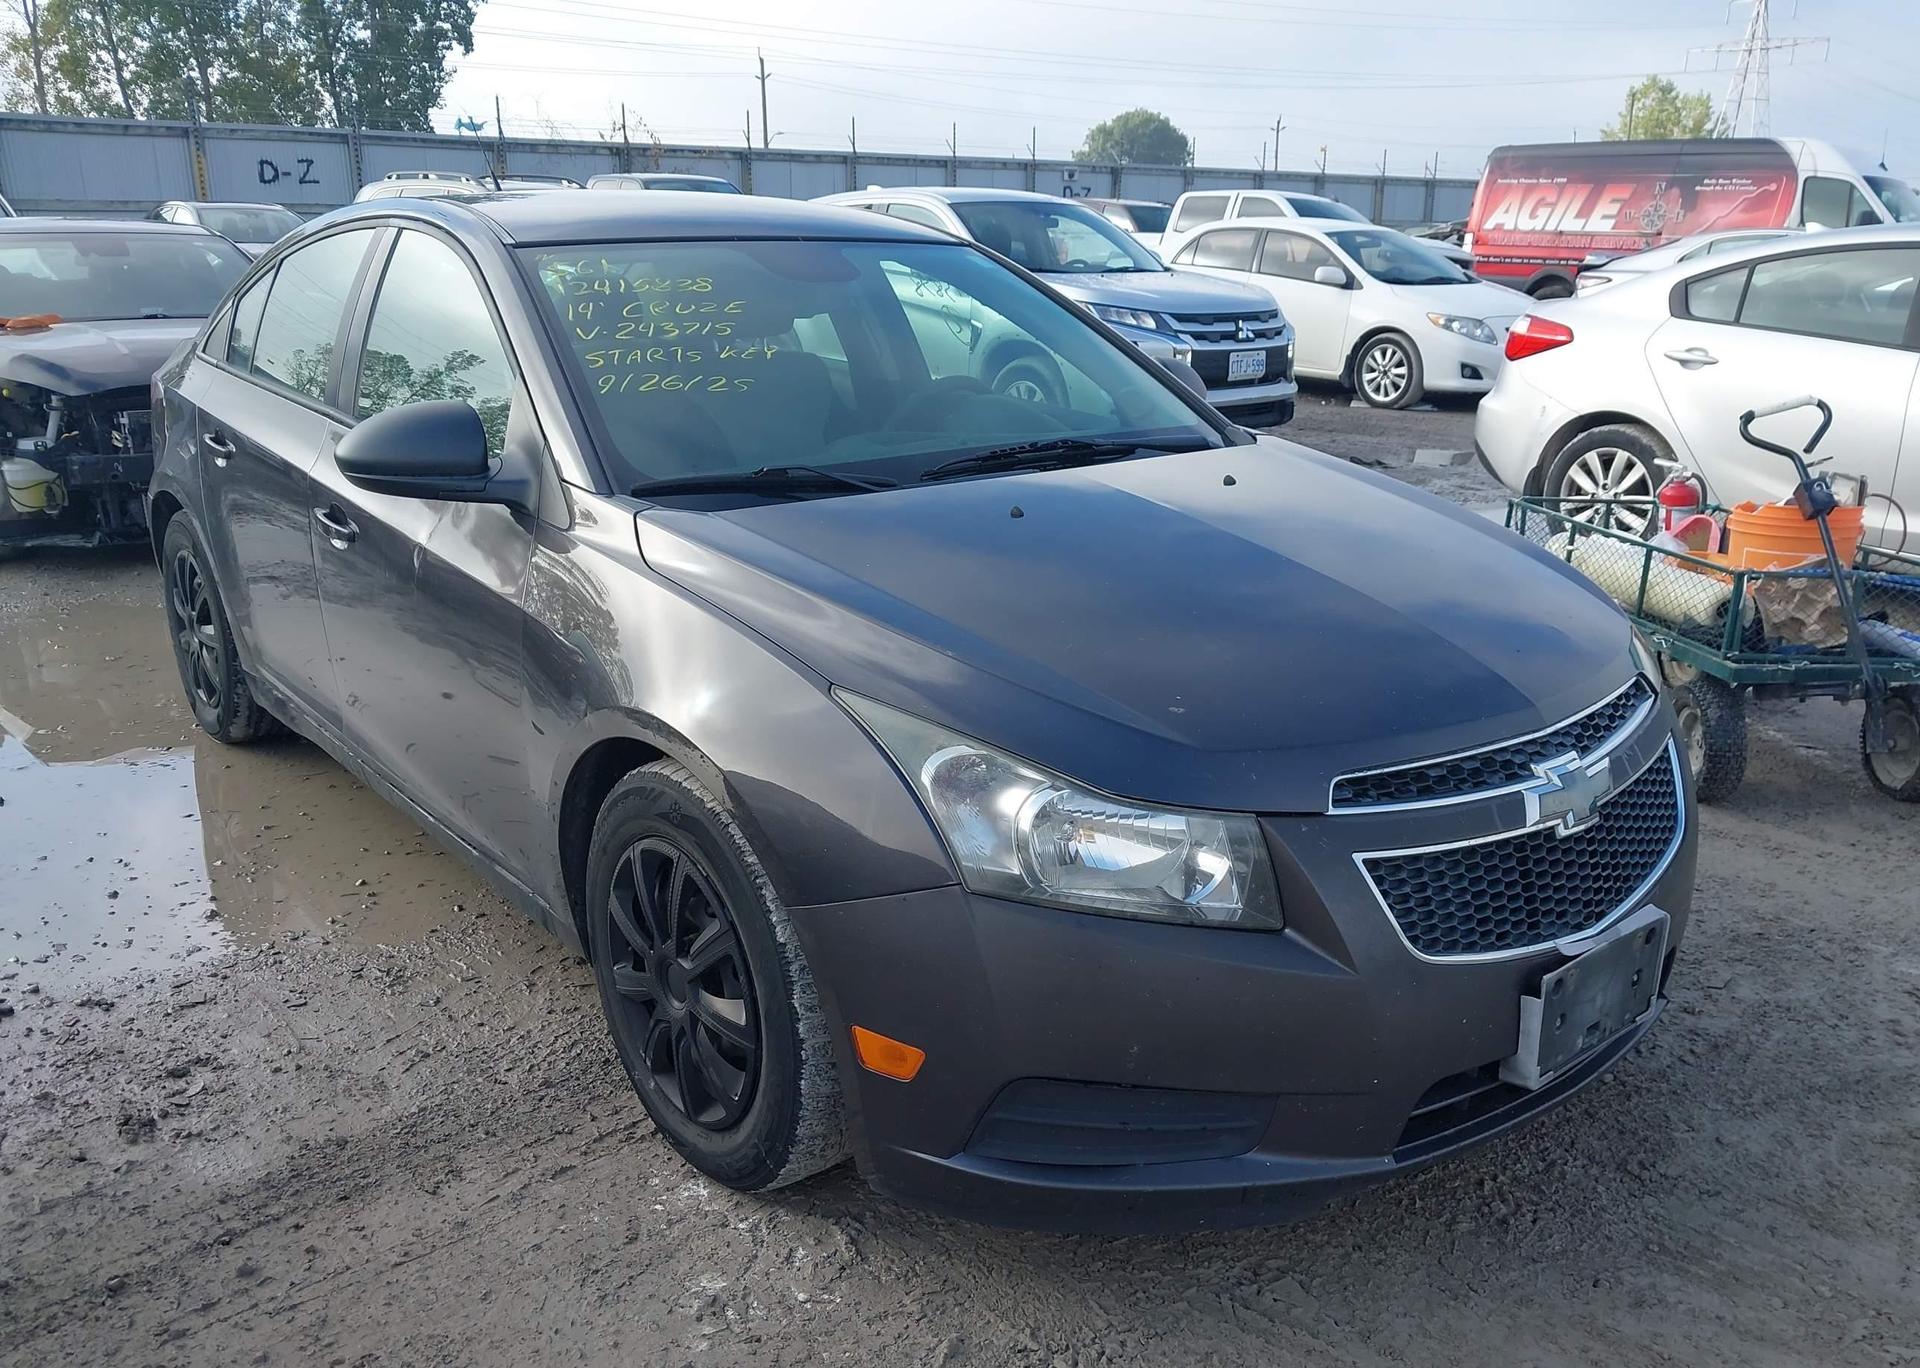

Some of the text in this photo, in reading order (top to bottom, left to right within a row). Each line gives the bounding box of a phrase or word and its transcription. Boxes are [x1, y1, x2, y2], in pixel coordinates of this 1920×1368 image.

[258, 158, 320, 184] D-Z
[1483, 184, 1636, 232] AGILE
[623, 301, 747, 318] CRUZE
[585, 348, 701, 368] STARTS
[598, 374, 755, 394] 9/26/25
